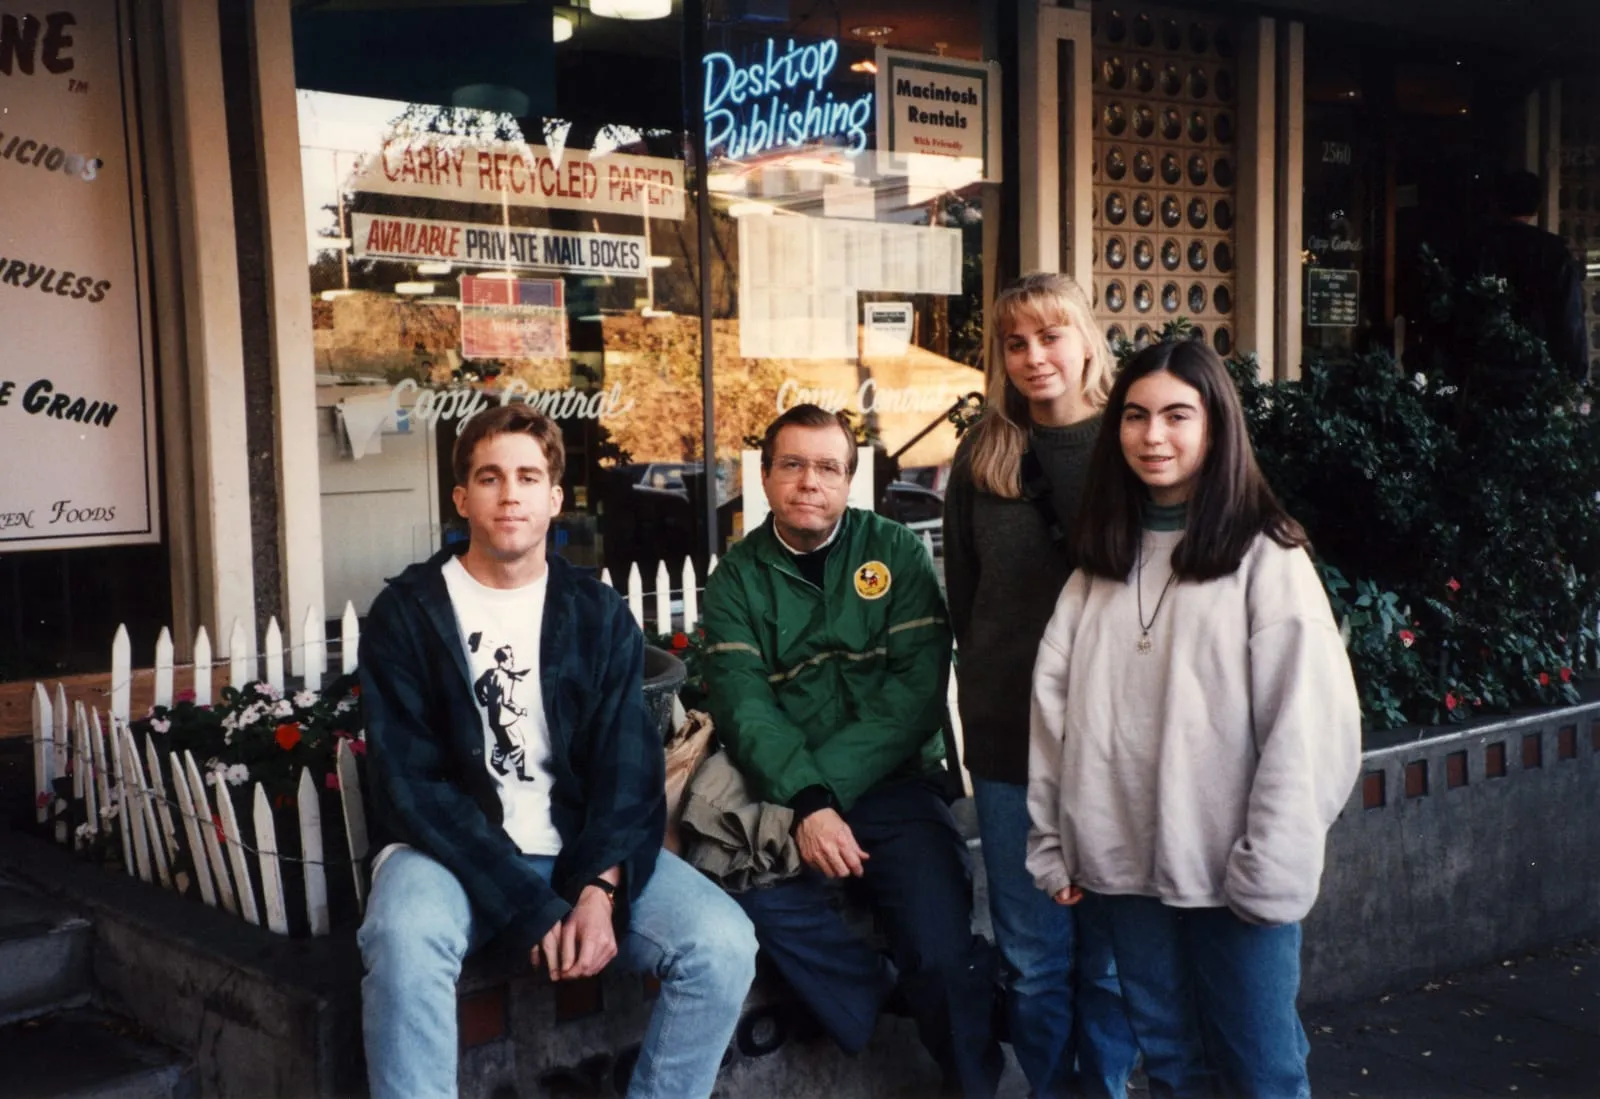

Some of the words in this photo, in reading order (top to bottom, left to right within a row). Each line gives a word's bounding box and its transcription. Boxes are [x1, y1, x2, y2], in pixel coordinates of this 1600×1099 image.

[702, 37, 838, 113] Desktop
[895, 78, 978, 106] Macintosh
[704, 90, 873, 160] Publishing
[907, 105, 968, 129] Rentals
[0, 131, 104, 181] ICIOUS
[381, 138, 465, 187] CARRY
[477, 151, 599, 200] RECYCLED
[608, 165, 675, 206] PAPER
[366, 219, 461, 257] AVAILABLE
[466, 229, 539, 264] PRIVATE
[543, 236, 586, 266] MAIL
[590, 239, 640, 269] BOXES
[22, 379, 118, 428] GRAIN
[387, 378, 488, 436] Copy
[500, 380, 634, 420] Central
